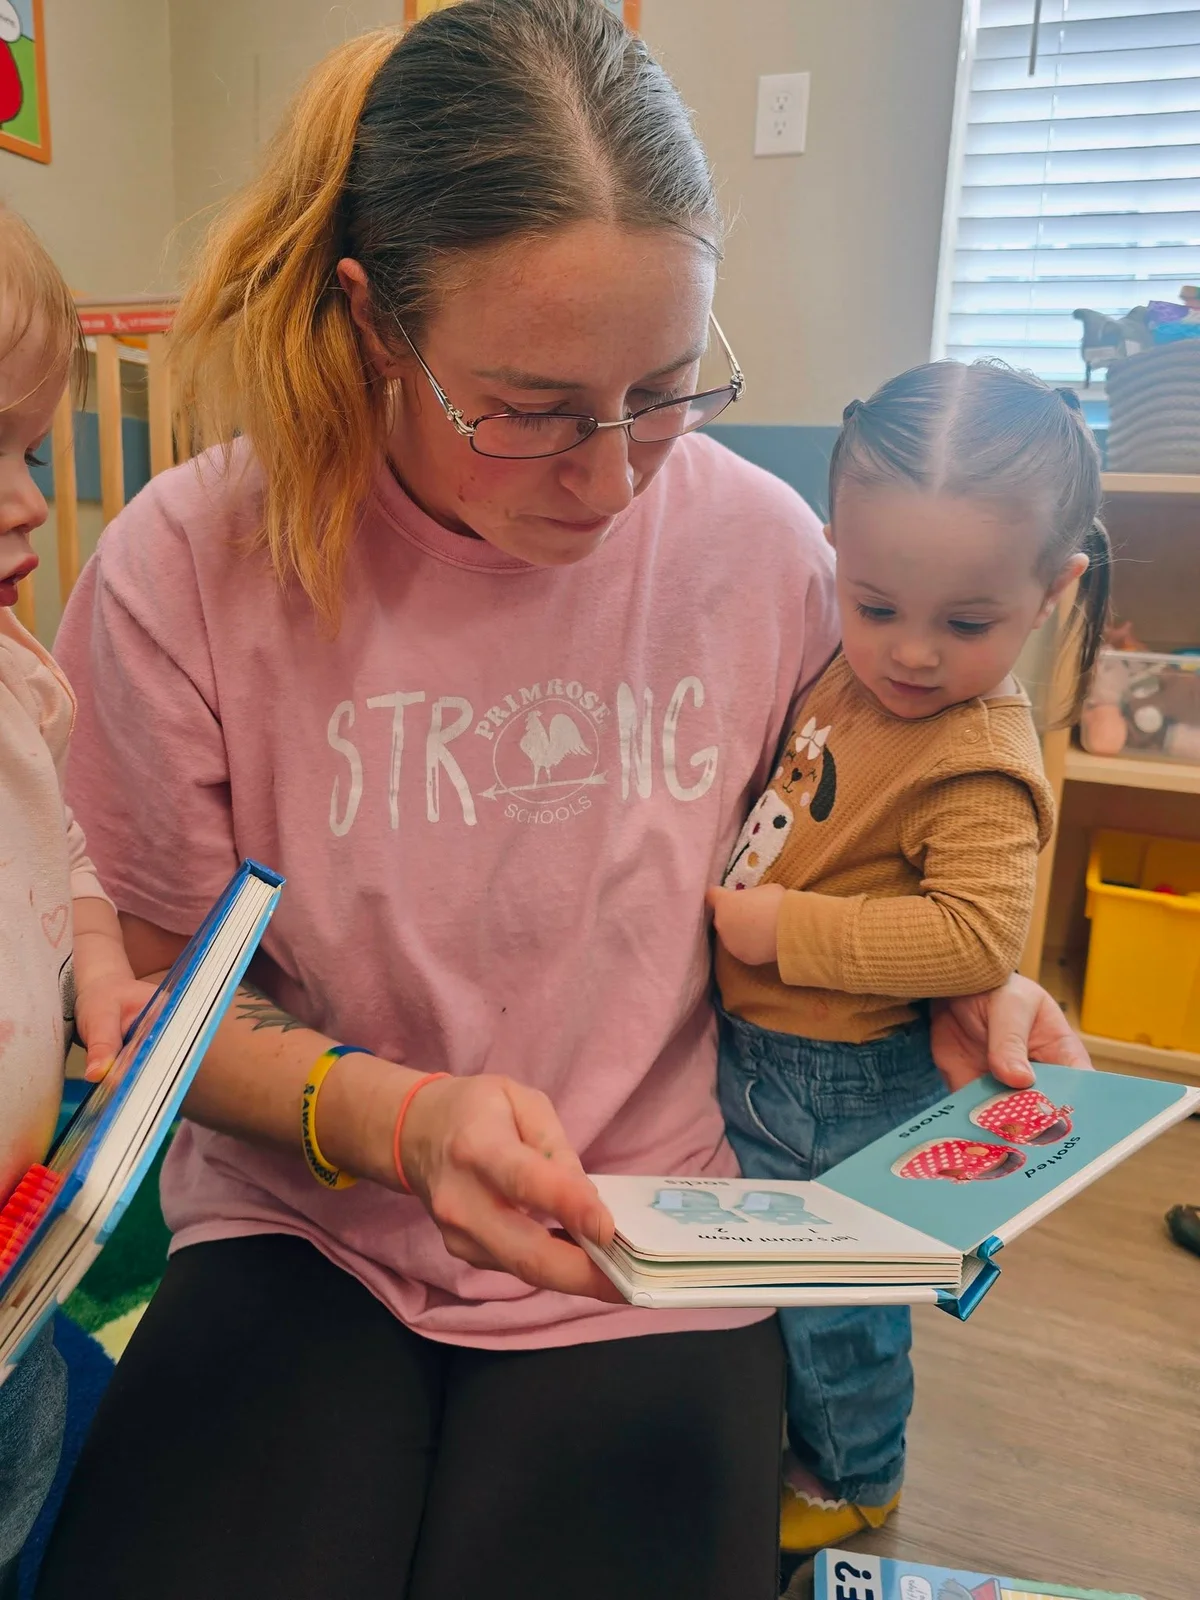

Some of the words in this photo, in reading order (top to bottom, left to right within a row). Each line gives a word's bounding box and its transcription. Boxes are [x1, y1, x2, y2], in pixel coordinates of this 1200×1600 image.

[474, 678, 611, 740] PRIMROSE
[504, 795, 592, 824] SCHOOLS
[898, 1104, 955, 1139] shoes
[1024, 1135, 1081, 1178] spotted
[664, 1179, 730, 1187] socks
[698, 1233, 753, 1243] them
[817, 1235, 859, 1243] let's
